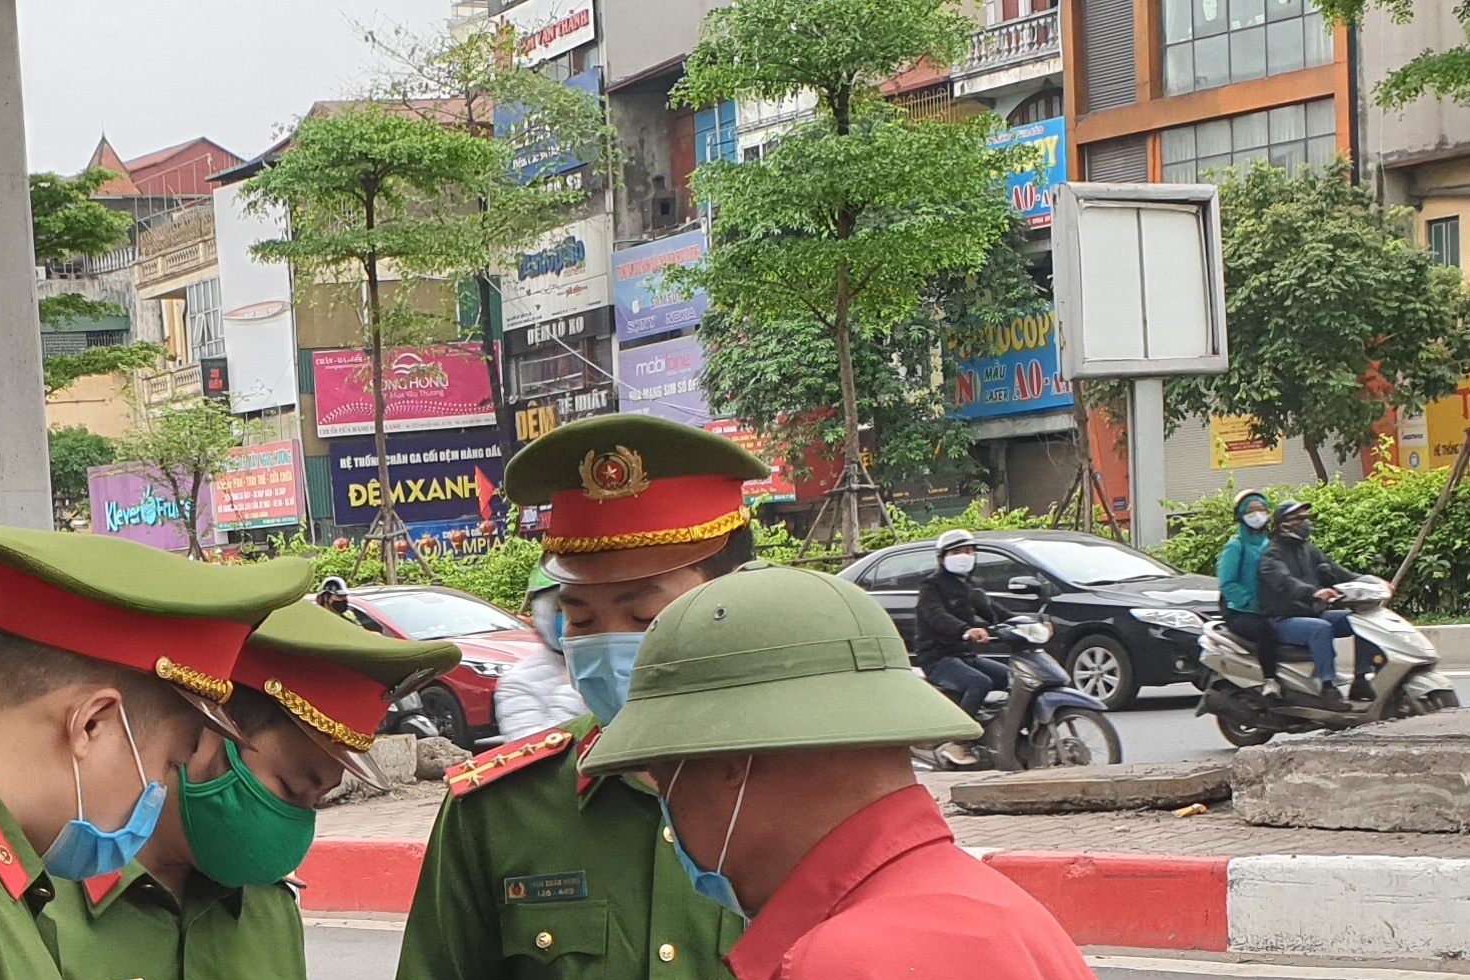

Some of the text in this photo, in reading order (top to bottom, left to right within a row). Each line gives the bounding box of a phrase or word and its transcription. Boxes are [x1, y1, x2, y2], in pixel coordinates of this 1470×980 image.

[340, 455, 353, 471] HỆ
[353, 452, 380, 468] THỐN
[409, 453, 422, 464] GA
[422, 448, 438, 463] GỐI
[460, 447, 483, 460] HÀNG
